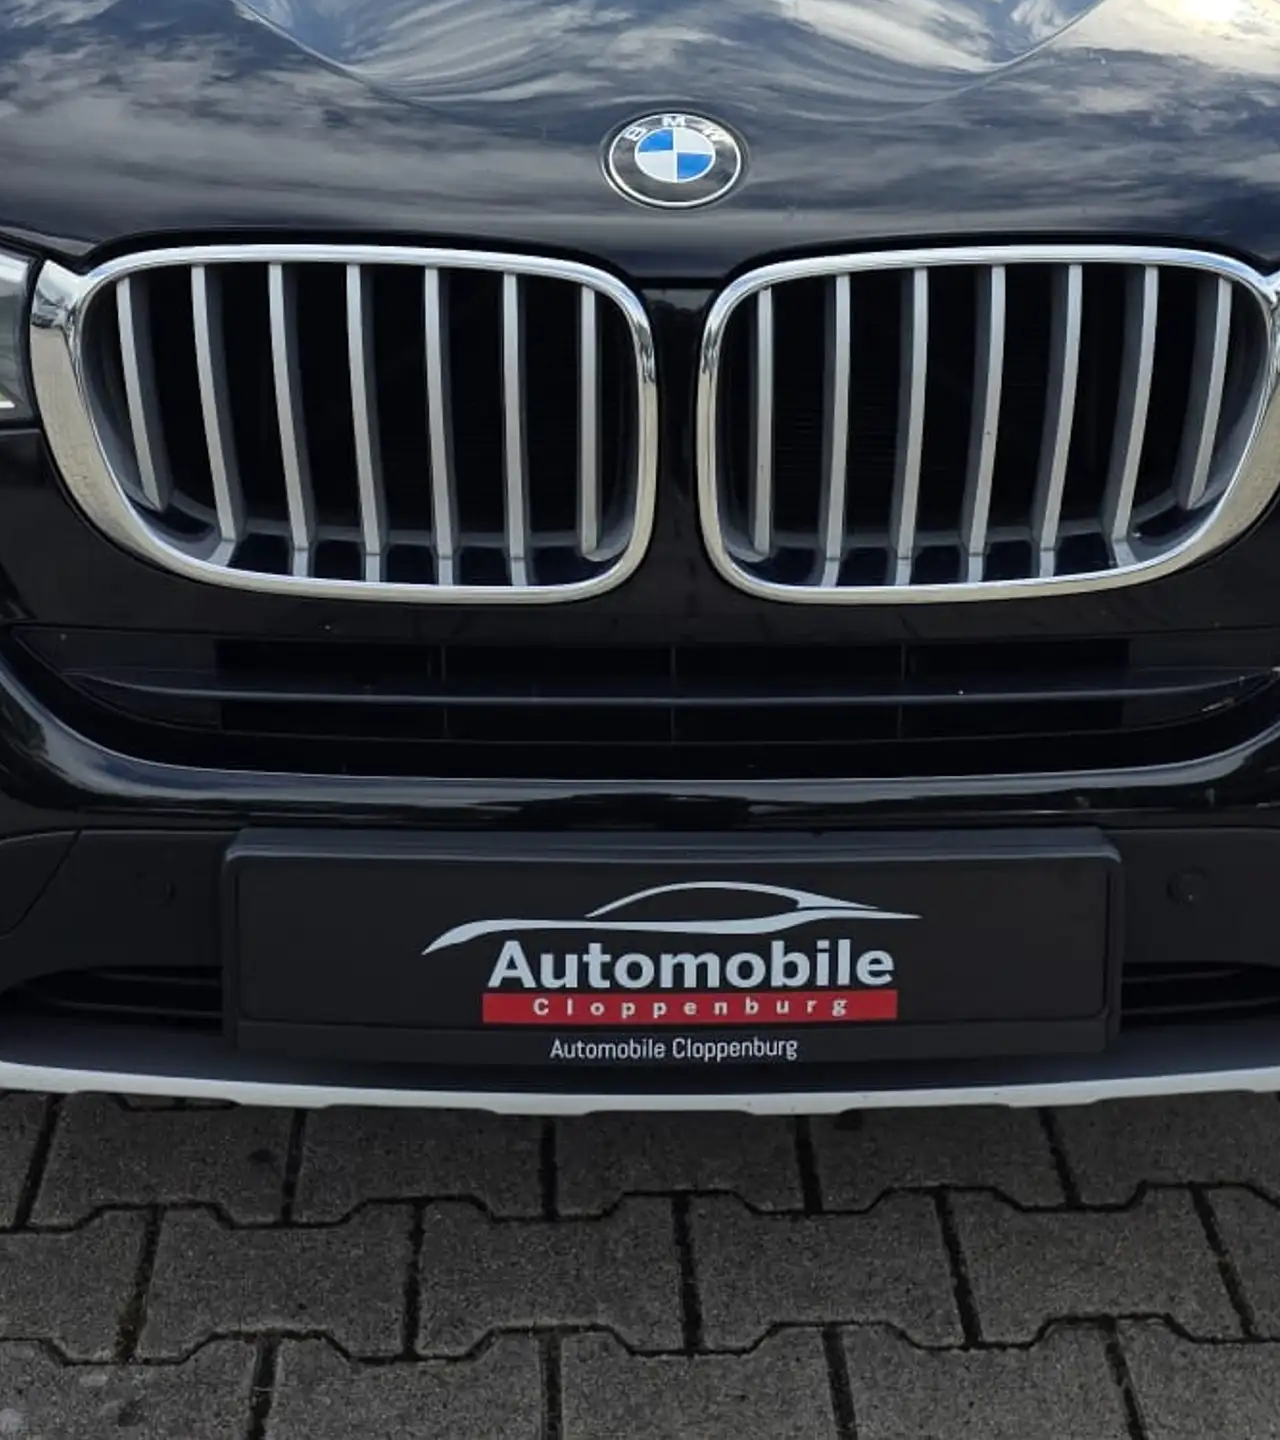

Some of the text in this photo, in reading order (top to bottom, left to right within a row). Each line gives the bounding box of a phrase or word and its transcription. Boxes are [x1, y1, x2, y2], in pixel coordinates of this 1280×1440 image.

[623, 114, 730, 143] BMW
[488, 938, 895, 989] Automobile
[532, 997, 848, 1018] Cloppenburg
[550, 1037, 798, 1061] Automobile Cloppenburg
